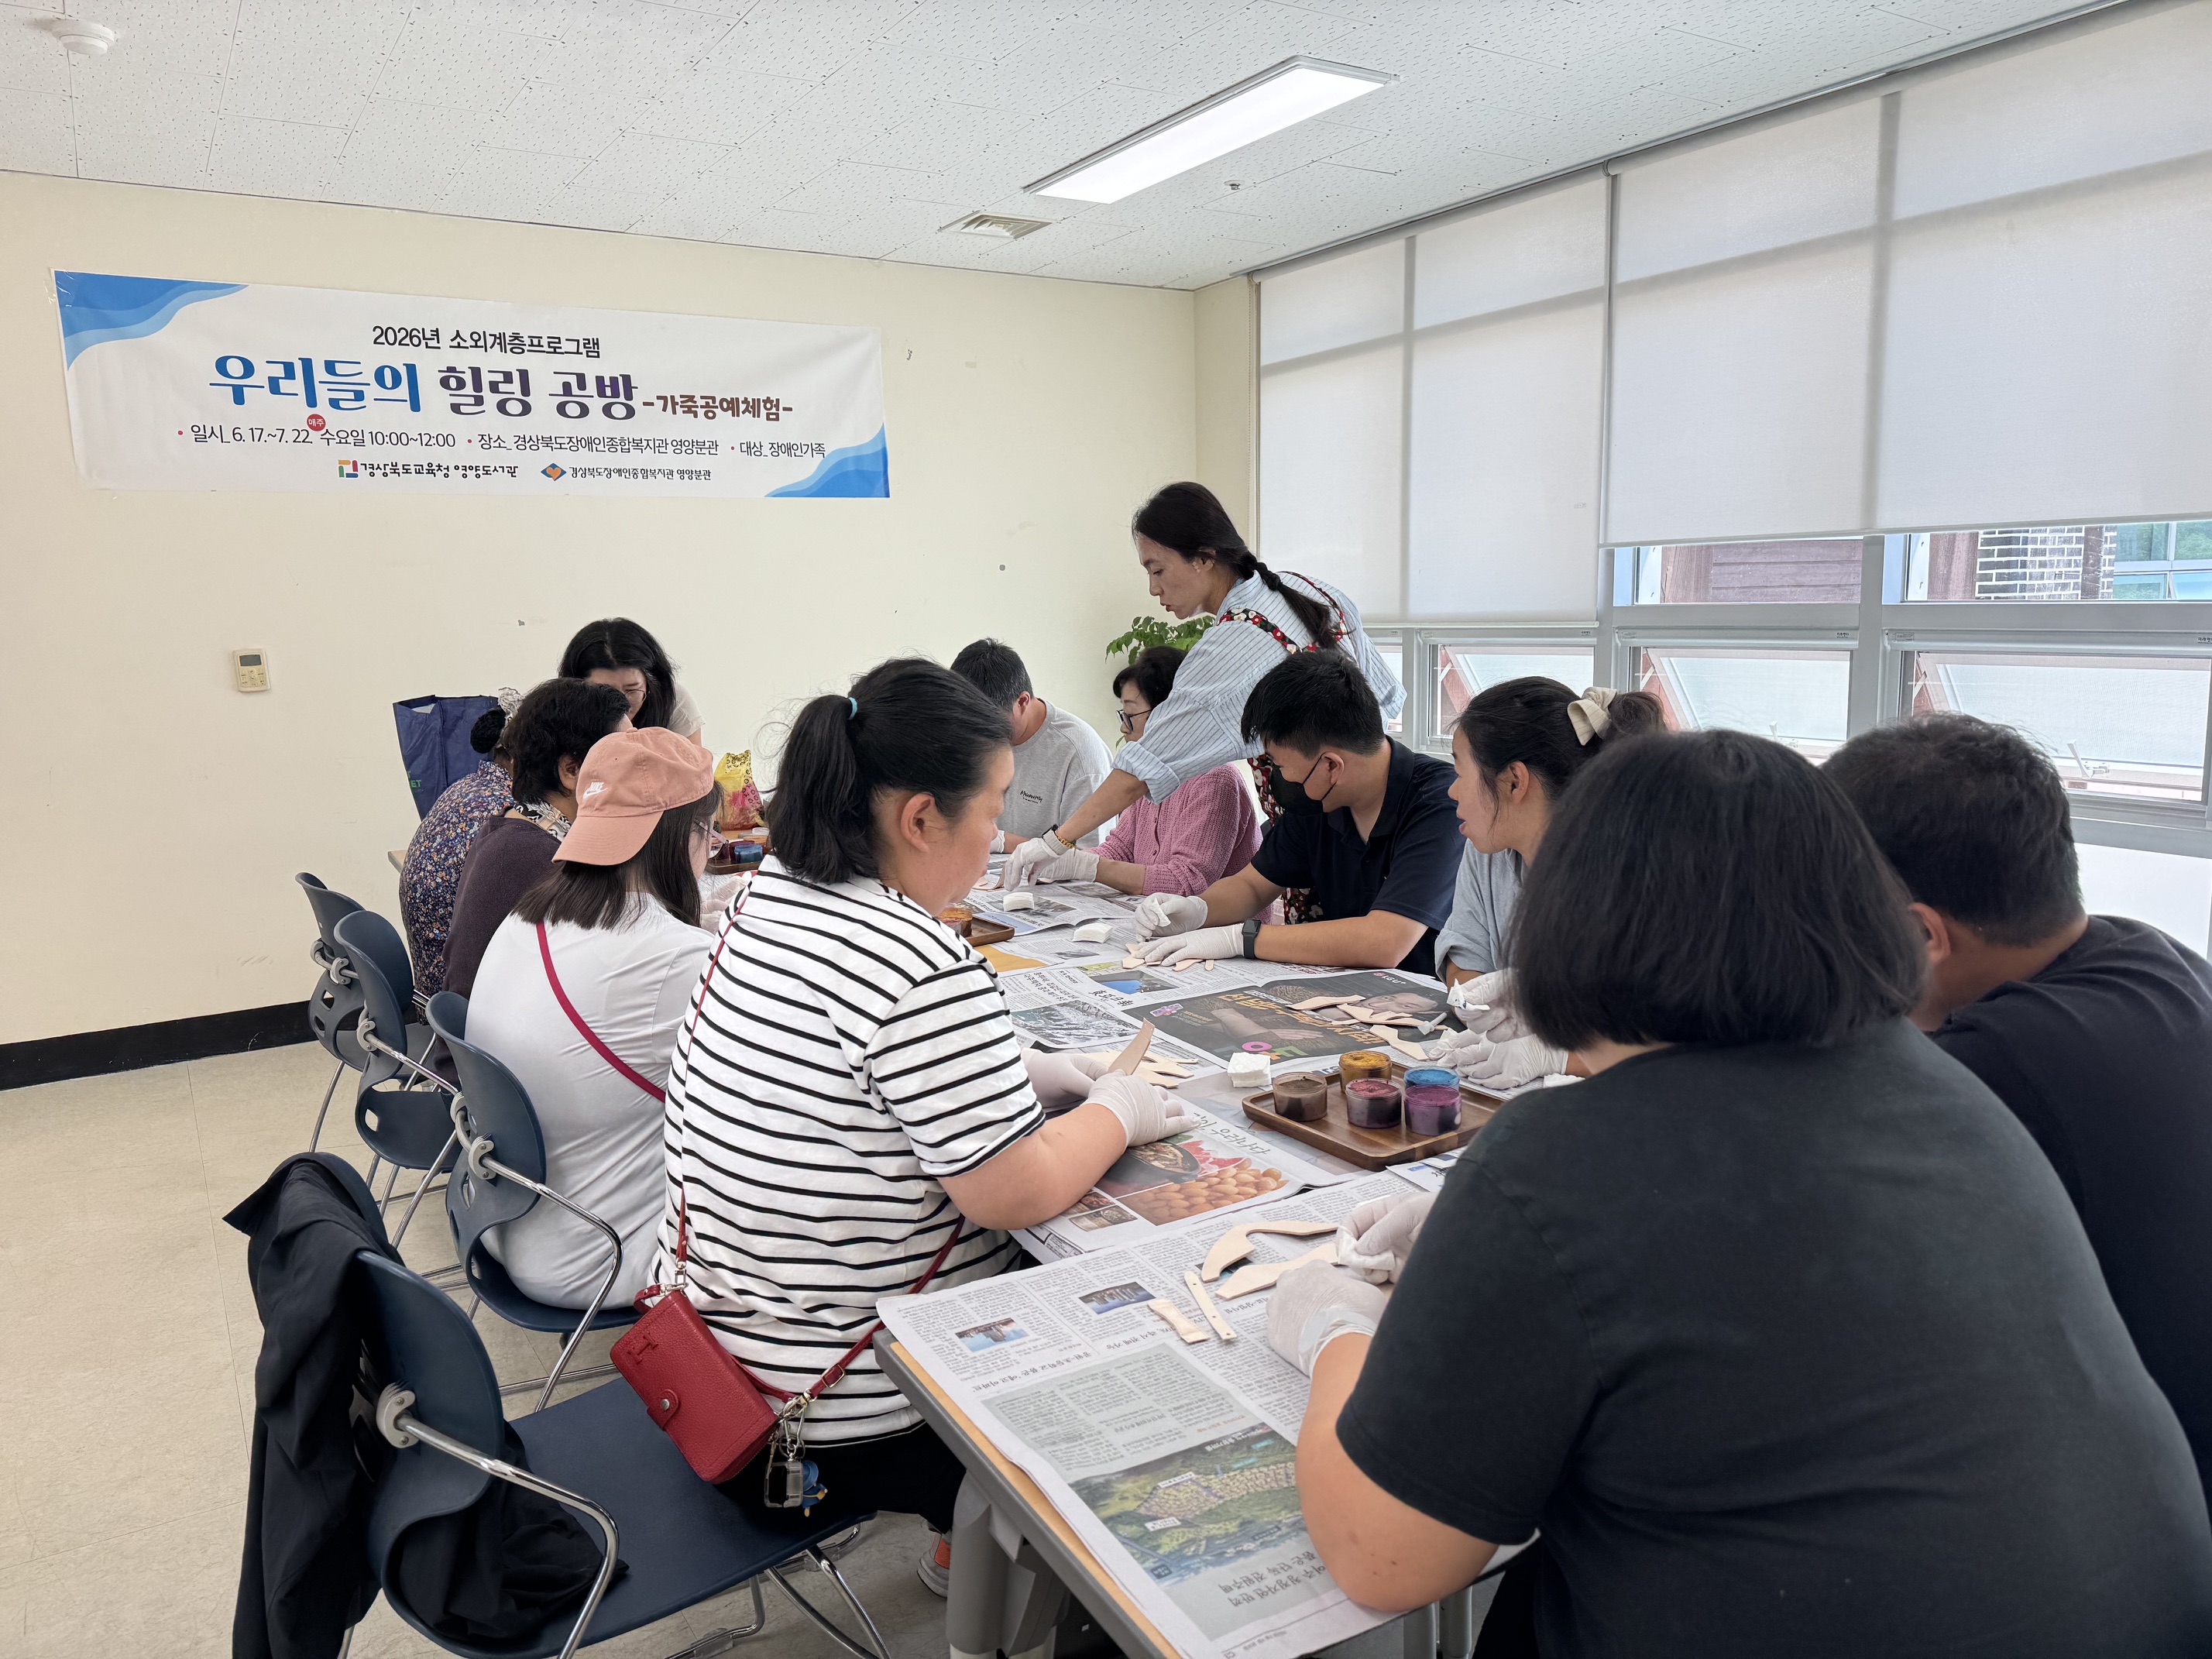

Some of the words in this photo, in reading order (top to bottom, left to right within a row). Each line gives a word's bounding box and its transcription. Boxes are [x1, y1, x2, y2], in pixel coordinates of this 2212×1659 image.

[372, 325, 441, 350] 2026년
[449, 331, 600, 359] 소외계층프로그램
[208, 355, 421, 413] 우리들의
[438, 366, 532, 417] 힐링
[548, 370, 638, 421] 공방
[307, 418, 325, 427] 매주
[320, 428, 366, 447] 수요일
[368, 431, 456, 448] 10:00~12:00
[514, 434, 669, 455] 경상북도장애인종합복지관
[671, 438, 719, 455] 영양분관
[768, 441, 826, 459] 장애인가족
[360, 461, 450, 479] 경상북도교육청
[453, 465, 519, 479] 영양도서관
[568, 466, 675, 480] 경상북도장애인종합복지관
[677, 469, 712, 481] 영양분관
[587, 781, 604, 792] NIKE
[1211, 1128, 1271, 1155] 우러나다
